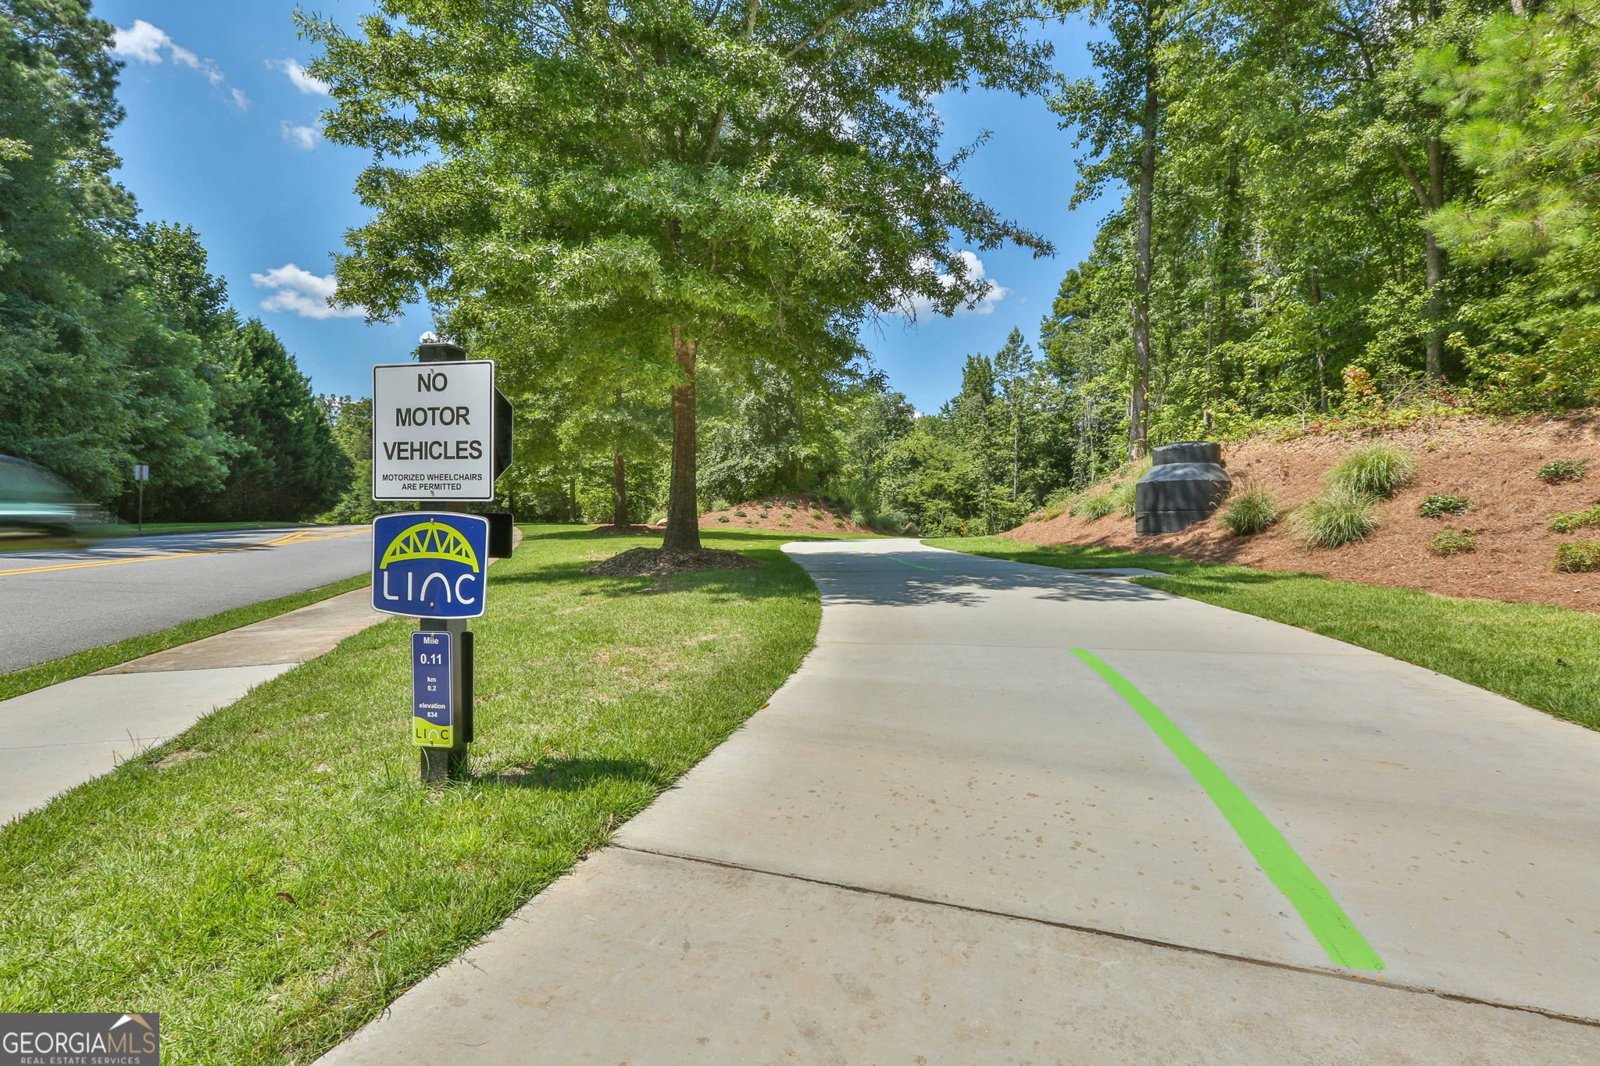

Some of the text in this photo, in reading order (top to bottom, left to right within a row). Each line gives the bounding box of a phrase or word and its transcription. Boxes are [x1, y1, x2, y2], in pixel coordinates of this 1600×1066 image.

[417, 372, 448, 392] NO
[395, 406, 471, 427] MOTOR
[383, 440, 483, 460] VEHICLES
[427, 473, 483, 481] WHEELCHAIRS
[401, 483, 461, 491] ARE PERMITTED
[423, 636, 439, 645] Mile
[420, 653, 442, 665] 0.11
